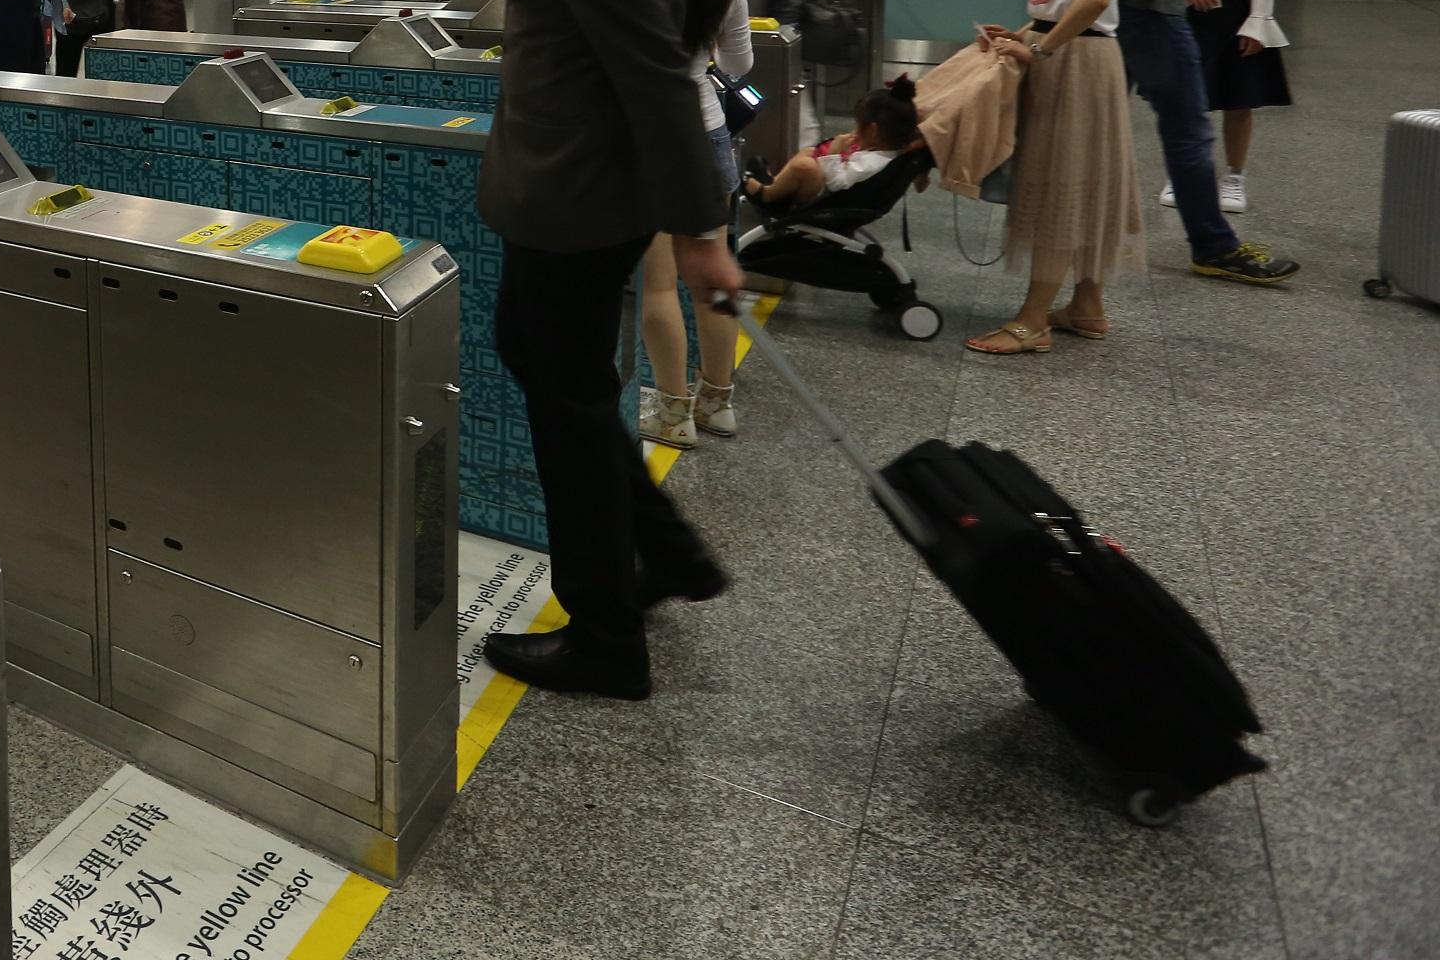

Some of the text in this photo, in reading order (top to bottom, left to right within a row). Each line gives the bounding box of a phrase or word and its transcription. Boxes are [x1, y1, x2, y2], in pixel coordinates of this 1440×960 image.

[457, 604, 484, 623] the
[476, 571, 510, 606] yellow
[496, 553, 524, 576] line
[490, 608, 512, 634] card
[507, 599, 519, 614] to
[513, 561, 549, 603] processor
[187, 851, 283, 957] yellow line
[243, 868, 314, 952] processor
